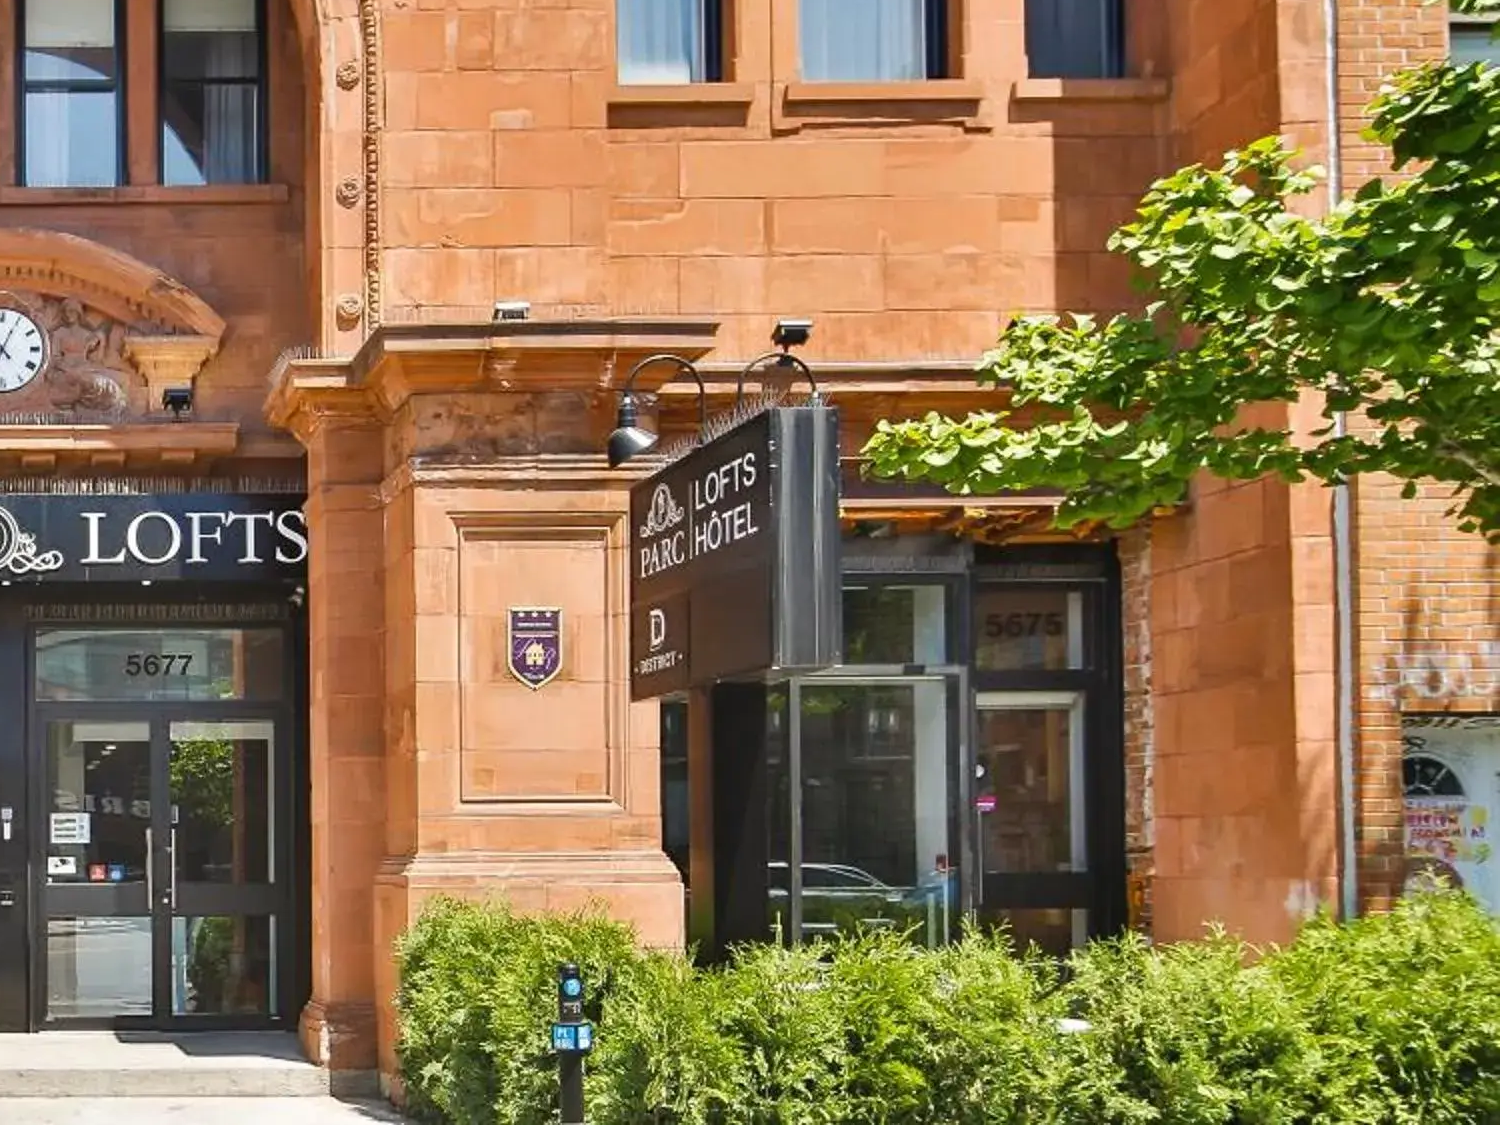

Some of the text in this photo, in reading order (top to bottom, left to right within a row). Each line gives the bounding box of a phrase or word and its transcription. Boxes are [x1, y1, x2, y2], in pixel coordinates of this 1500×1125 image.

[695, 452, 756, 510] LOFTS
[80, 511, 309, 566] LOFTS
[695, 502, 759, 556] HÔTEL
[641, 530, 685, 578] PARC
[649, 609, 665, 652] D
[985, 613, 1063, 638] 5675
[125, 654, 194, 676] 5677
